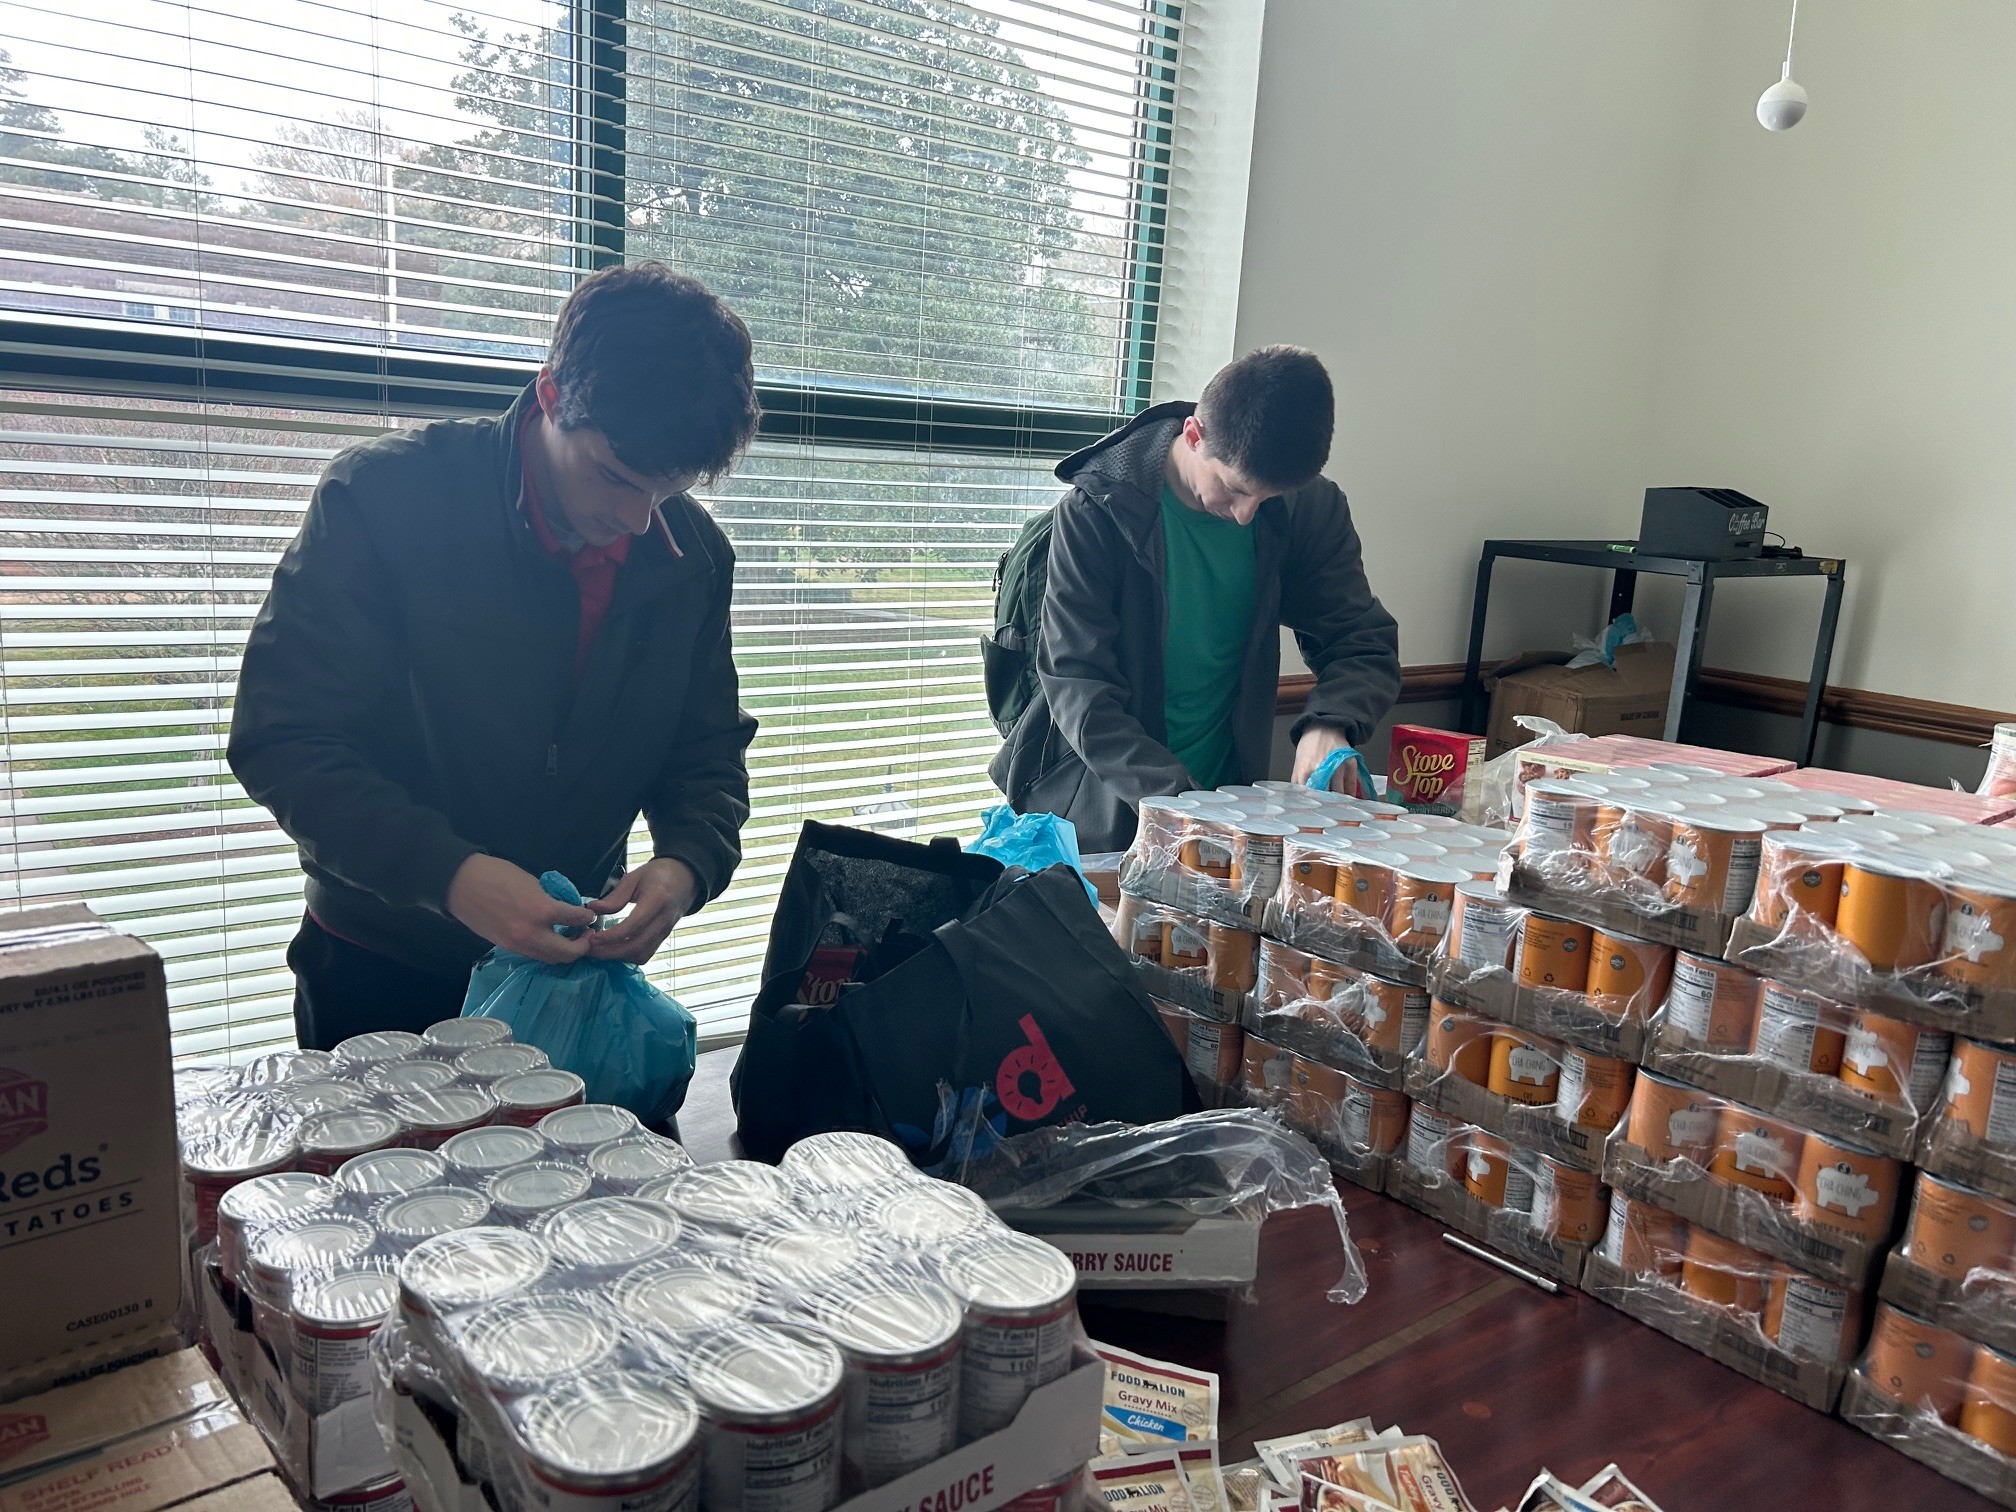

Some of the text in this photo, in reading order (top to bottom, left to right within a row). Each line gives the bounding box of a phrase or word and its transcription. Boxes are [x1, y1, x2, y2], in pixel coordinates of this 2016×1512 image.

[1750, 511, 1766, 531] Bar
[1393, 745, 1455, 785] Stove
[1411, 773, 1444, 799] Top
[1511, 1055, 1546, 1071] CHA-CHING
[1114, 1253, 1173, 1272] SAUCE
[1110, 1371, 1186, 1398] FOOD LION
[1118, 1390, 1178, 1414] Gravy Mix
[1127, 1414, 1165, 1432] Chicken
[745, 1437, 802, 1451] Nutrition
[919, 1464, 994, 1512] SAUCE
[1140, 1484, 1165, 1496] LION
[1421, 1474, 1444, 1510] Gravy
[1433, 1465, 1454, 1496] FOOD
